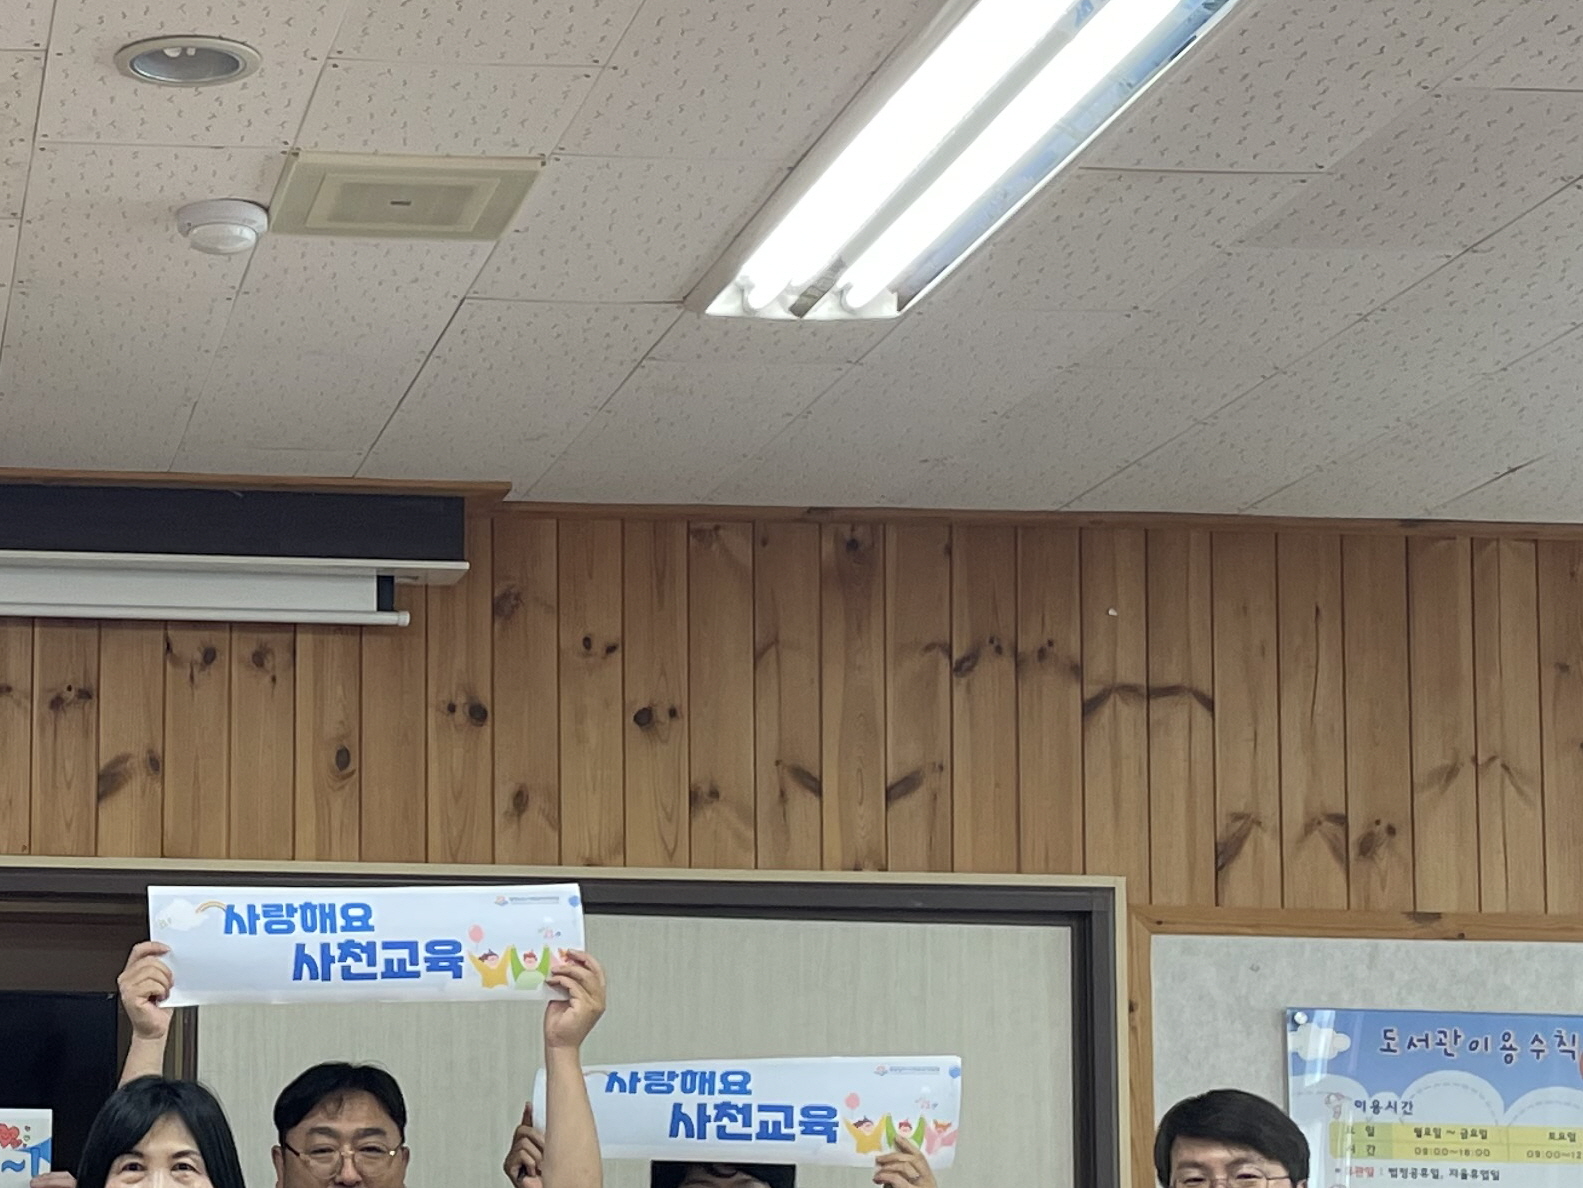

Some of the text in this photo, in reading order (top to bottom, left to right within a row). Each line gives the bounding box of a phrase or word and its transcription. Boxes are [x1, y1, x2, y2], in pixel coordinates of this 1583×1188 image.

[224, 902, 375, 936] 사랑해요
[292, 939, 464, 982] 사천교육
[605, 1069, 752, 1096] 사랑해요
[669, 1101, 839, 1144] 사천교육
